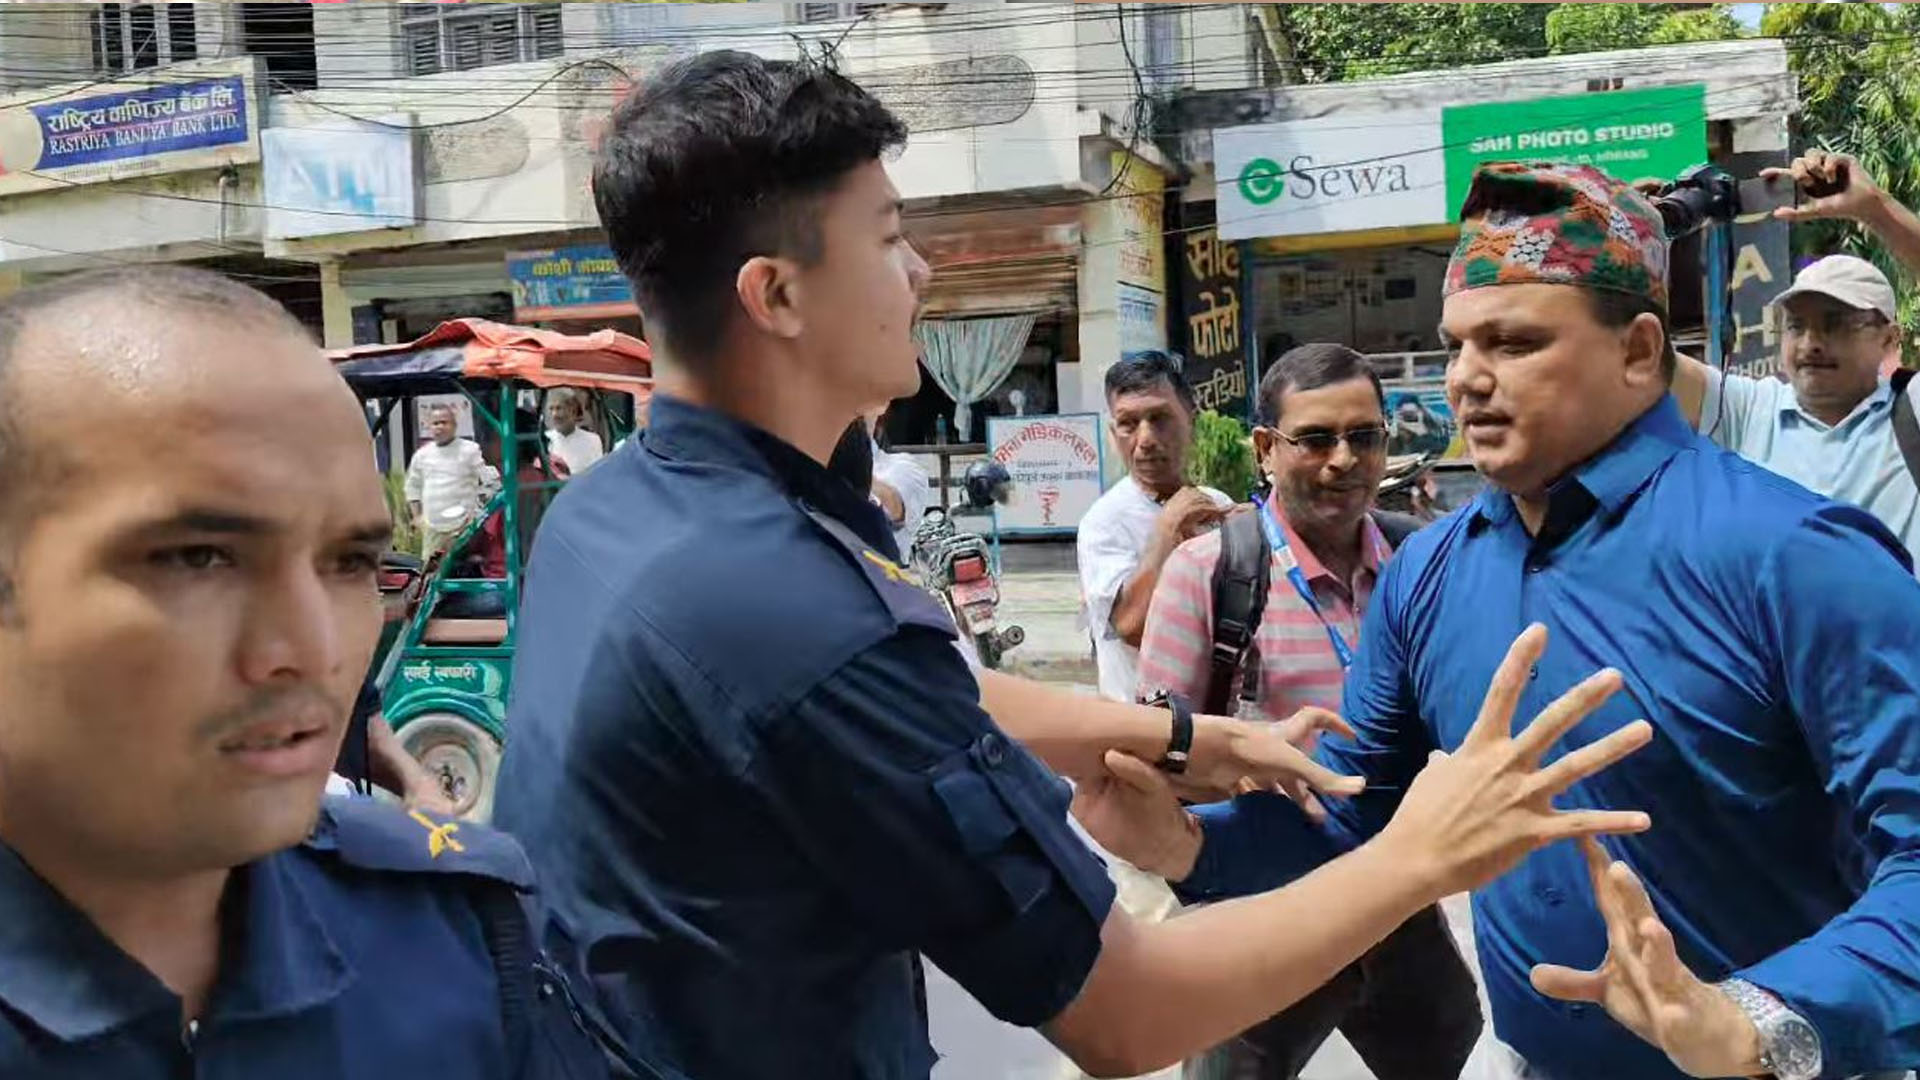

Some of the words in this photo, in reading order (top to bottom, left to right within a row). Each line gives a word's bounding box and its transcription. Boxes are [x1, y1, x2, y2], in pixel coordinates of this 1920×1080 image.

[49, 132, 110, 155] RASTRIYA
[172, 118, 206, 138] BANK
[1517, 128, 1589, 150] PHOTO
[1594, 122, 1674, 142] STUDIO
[1190, 286, 1240, 359] फोटो
